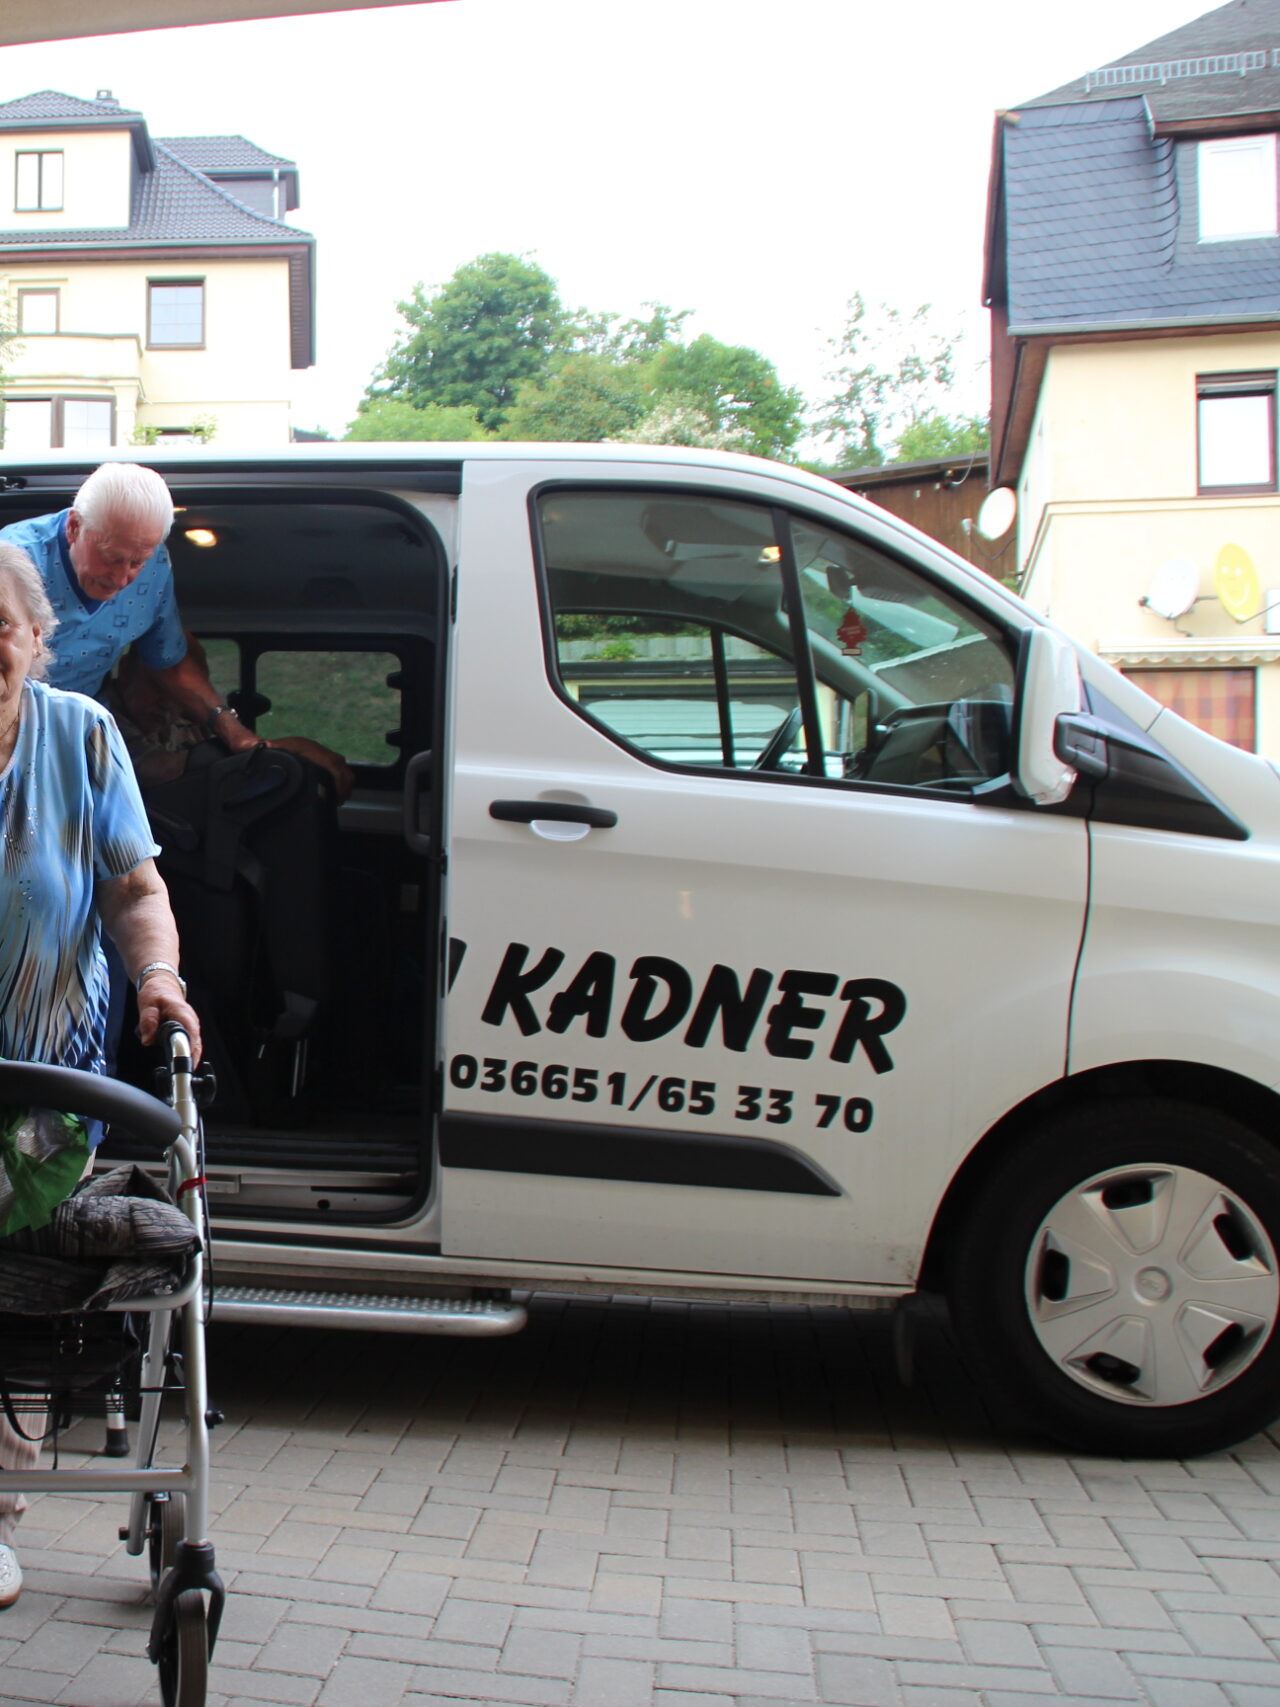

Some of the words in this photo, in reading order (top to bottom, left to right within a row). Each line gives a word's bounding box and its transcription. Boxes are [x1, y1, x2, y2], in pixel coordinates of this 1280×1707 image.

[480, 942, 907, 1075] KADNER
[449, 1053, 716, 1116] 036651/65
[734, 1085, 794, 1125] 33
[815, 1093, 874, 1134] 70
